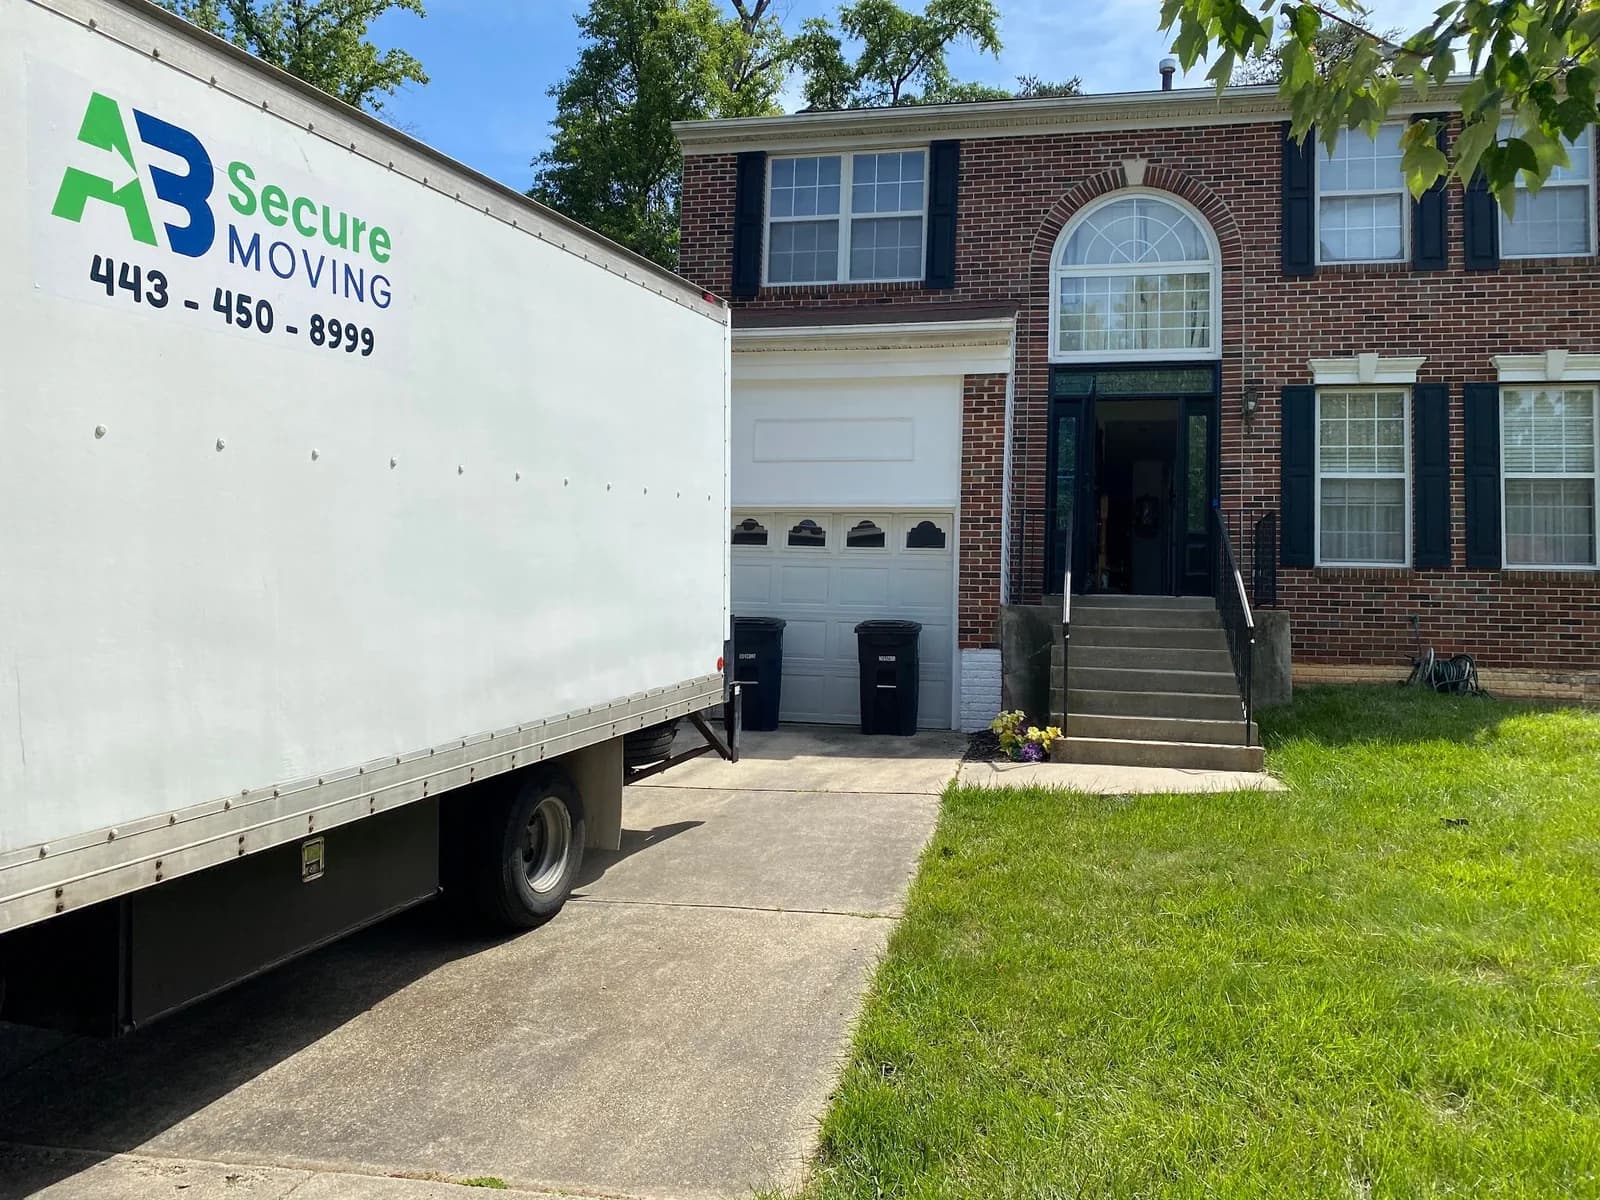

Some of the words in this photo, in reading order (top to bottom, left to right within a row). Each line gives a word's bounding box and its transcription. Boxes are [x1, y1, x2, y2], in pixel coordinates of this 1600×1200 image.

[52, 91, 215, 258] AB
[227, 161, 392, 263] Secure
[90, 254, 169, 309] 443
[213, 287, 274, 334] 450
[309, 314, 375, 357] 8999
[229, 224, 392, 309] MOVING
